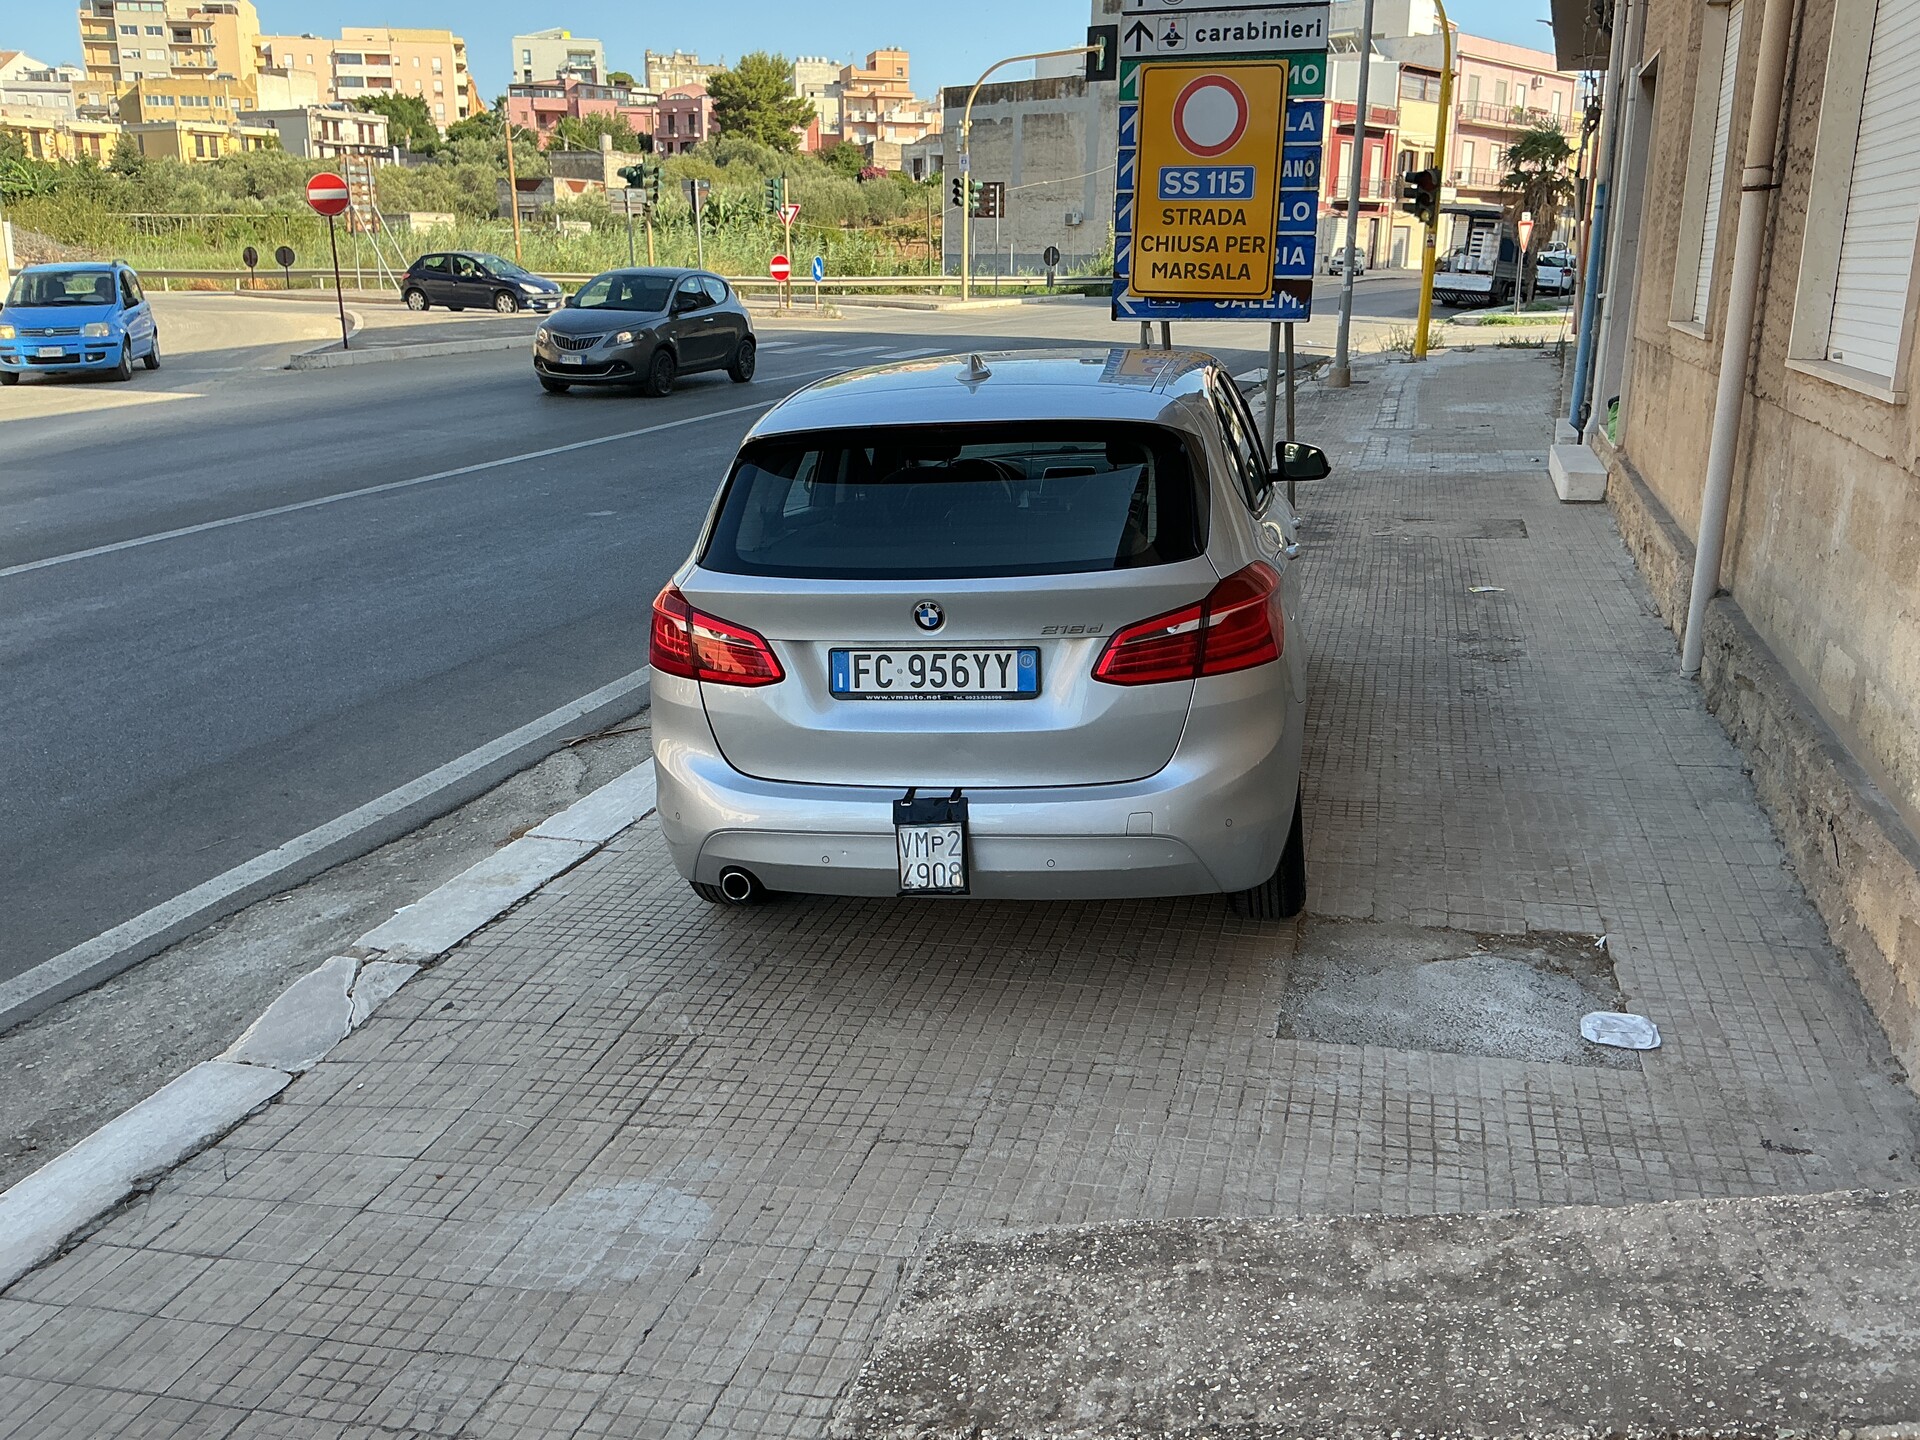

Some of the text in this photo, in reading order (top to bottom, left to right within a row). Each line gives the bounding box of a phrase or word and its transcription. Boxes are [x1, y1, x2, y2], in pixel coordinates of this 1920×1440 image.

[1195, 18, 1322, 43] carabinieri
[1164, 171, 1246, 195] SS 115
[1162, 208, 1247, 226] STRADA
[1140, 235, 1265, 253] CHIUSA PER
[1151, 262, 1251, 281] MARSALA
[853, 654, 893, 689] FC
[908, 653, 1012, 689] 956YY
[902, 862, 962, 888] 4908
